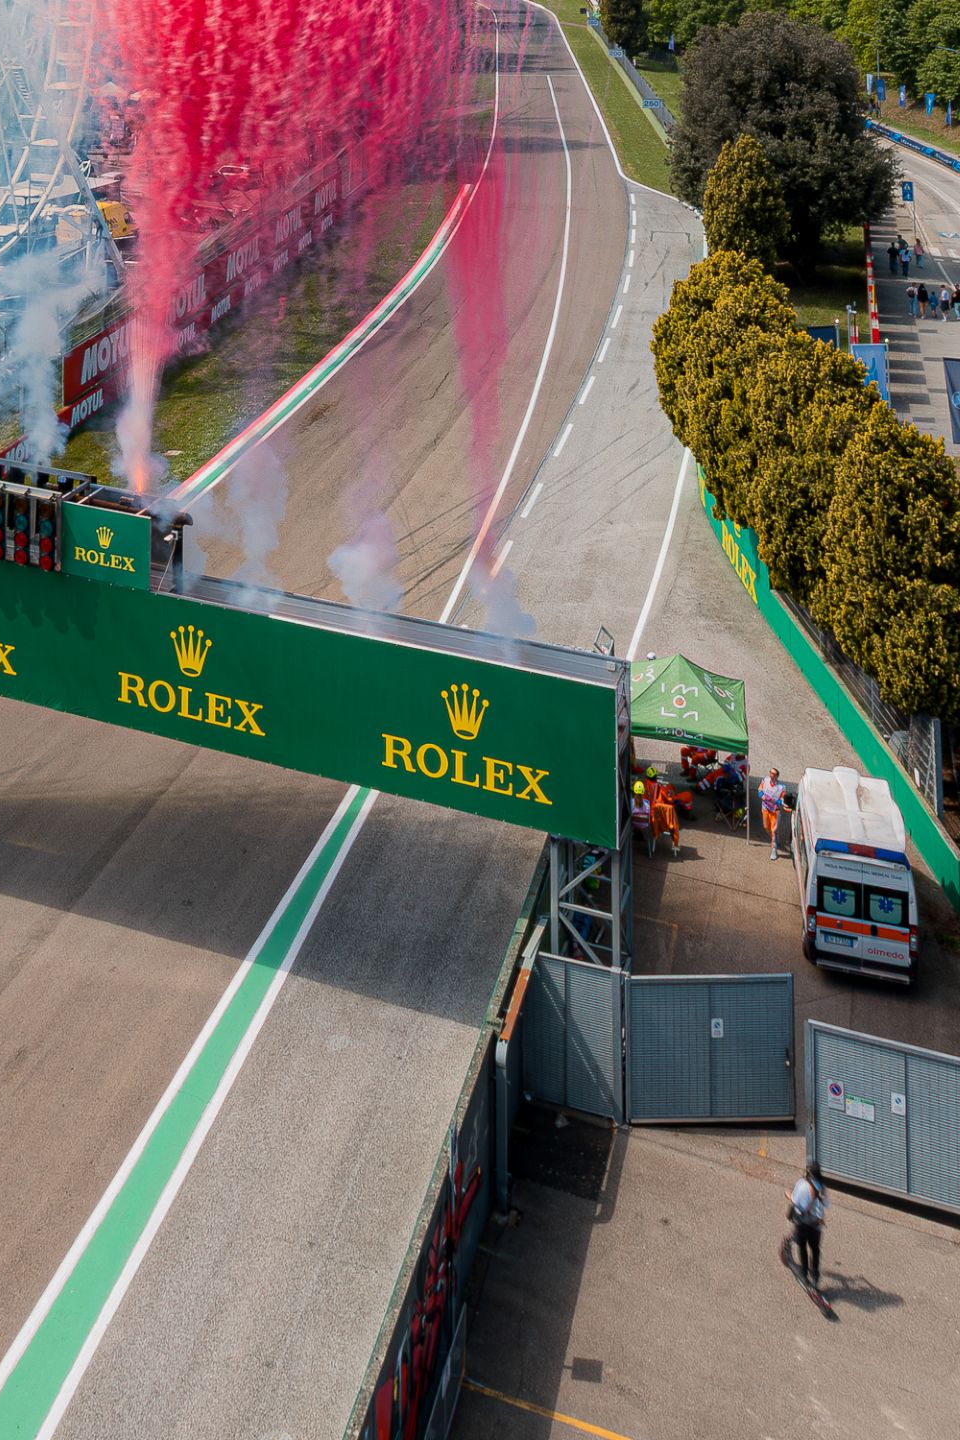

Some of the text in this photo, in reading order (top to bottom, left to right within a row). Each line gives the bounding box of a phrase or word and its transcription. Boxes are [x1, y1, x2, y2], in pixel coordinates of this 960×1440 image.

[226, 234, 260, 283] MOTUL
[70, 388, 105, 428] MOTUL
[74, 546, 136, 572] ROLEX
[722, 521, 758, 604] ROLEX
[117, 671, 266, 737] ROLEX
[381, 733, 553, 805] ROLEX
[867, 948, 904, 960] olmedo
